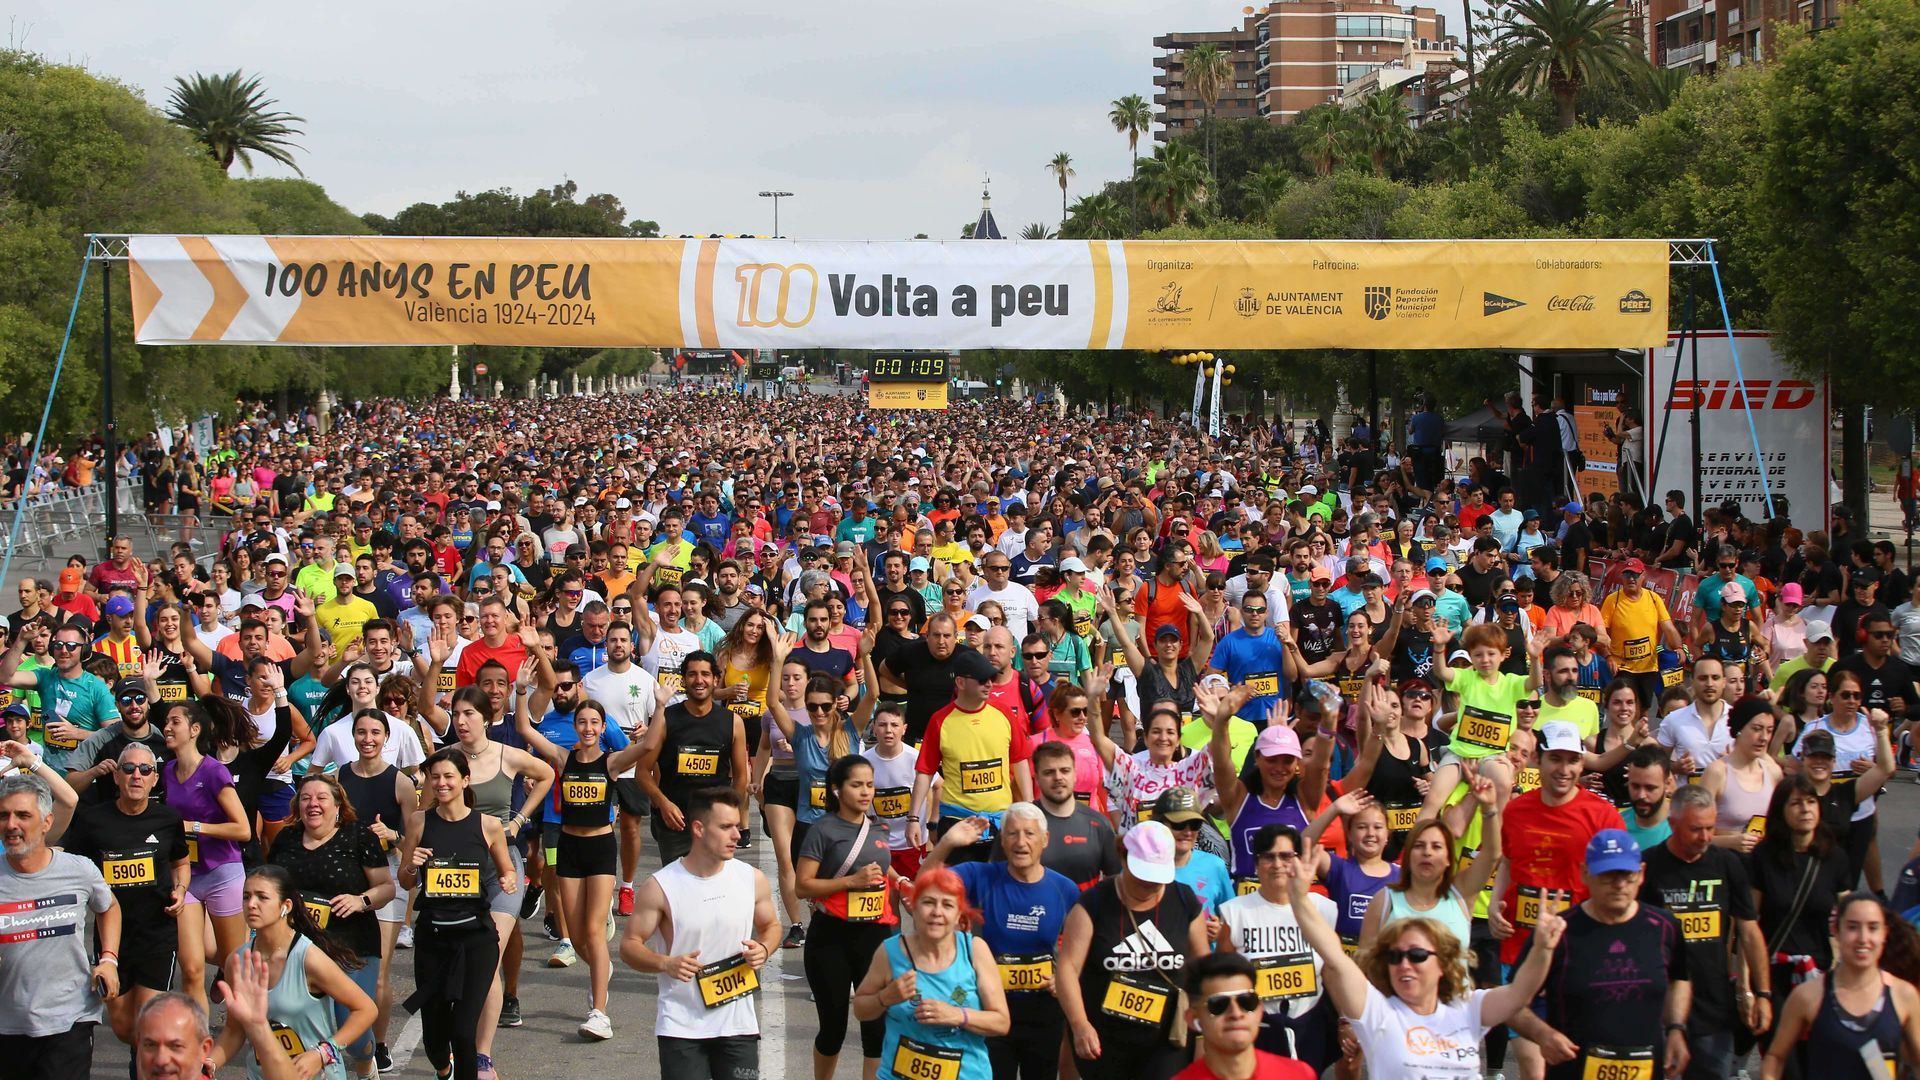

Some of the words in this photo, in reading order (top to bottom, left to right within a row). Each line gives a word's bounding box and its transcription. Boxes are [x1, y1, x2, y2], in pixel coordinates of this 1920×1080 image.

[1147, 259, 1194, 273] Organitza:
[1313, 259, 1360, 271] Patrocina:
[265, 262, 328, 297] 100
[337, 261, 434, 299] ANYS
[448, 263, 497, 300] EN
[510, 263, 592, 301] PEU
[735, 263, 819, 328] 100
[827, 273, 938, 317] Volta
[951, 284, 977, 317] a
[991, 284, 1069, 327] peu
[1267, 292, 1343, 302] AJUNTAMENT
[1395, 296, 1437, 304] Deportiva
[404, 301, 488, 324] València
[494, 303, 597, 326] 1924-2024
[1266, 305, 1281, 315] DE
[1286, 303, 1343, 315] VALÈNCIA
[1395, 304, 1436, 312] Municipal
[1664, 380, 1815, 410] SIED
[1699, 467, 1762, 476] NTEGRAL
[1768, 467, 1786, 476] DE
[662, 570, 679, 580] 6443
[1630, 645, 1647, 656] 6787
[1467, 721, 1501, 741] 3085
[685, 758, 712, 771] 4505
[971, 771, 995, 786] 4180
[569, 785, 598, 799] 6889
[882, 800, 903, 812] 234
[112, 863, 145, 881] 5906
[436, 873, 470, 889] 4635
[17, 902, 33, 910] NEW
[37, 898, 56, 907] YORK
[1684, 917, 1710, 934] 603
[13, 931, 35, 941] SINCE
[1103, 950, 1185, 971] adidas
[711, 971, 747, 996] 3014
[1008, 968, 1042, 986] 3013
[1266, 970, 1303, 991] 1686
[1119, 990, 1155, 1015] 1687
[1457, 1046, 1480, 1061] pe
[910, 1057, 942, 1080] 859
